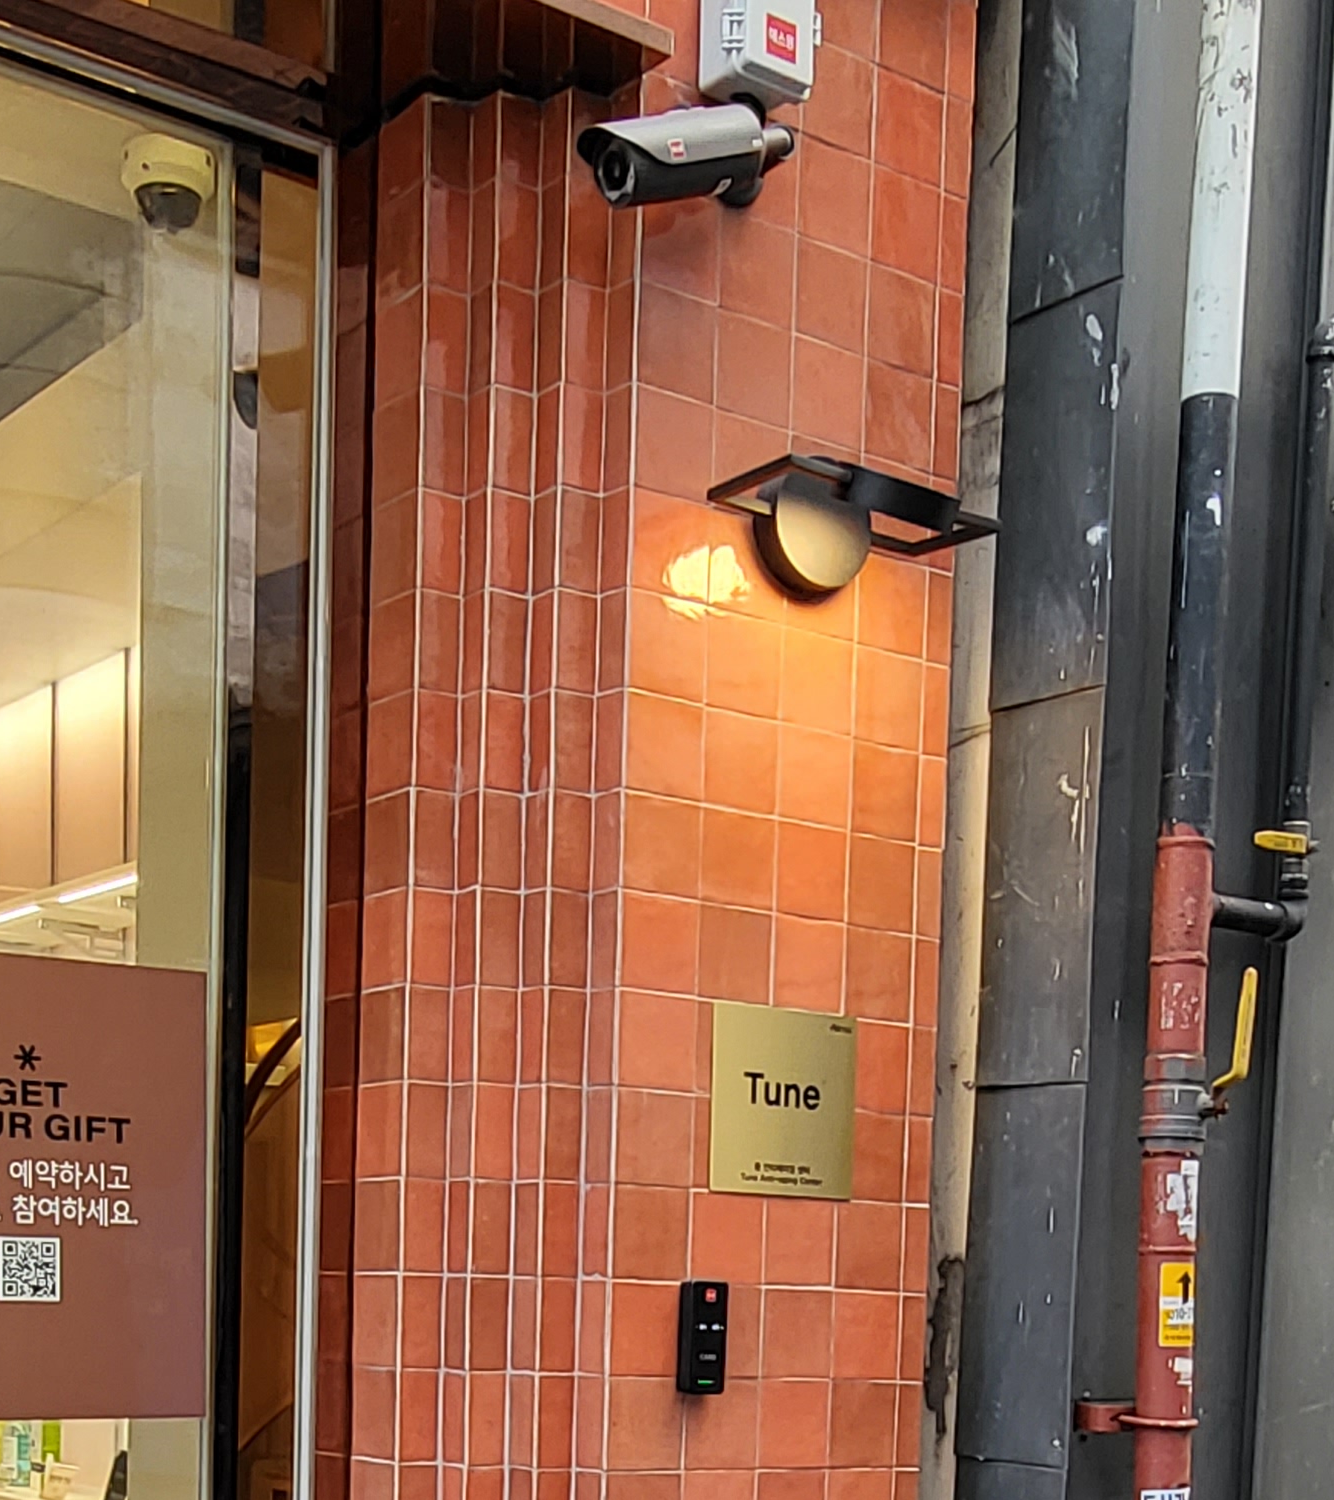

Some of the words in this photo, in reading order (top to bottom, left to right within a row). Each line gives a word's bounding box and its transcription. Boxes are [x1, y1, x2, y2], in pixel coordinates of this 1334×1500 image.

[743, 1071, 820, 1111] Tune
[44, 1114, 131, 1144] GIFT
[9, 1158, 131, 1192] 예약하시고
[12, 1194, 139, 1227] 참여하세요.
